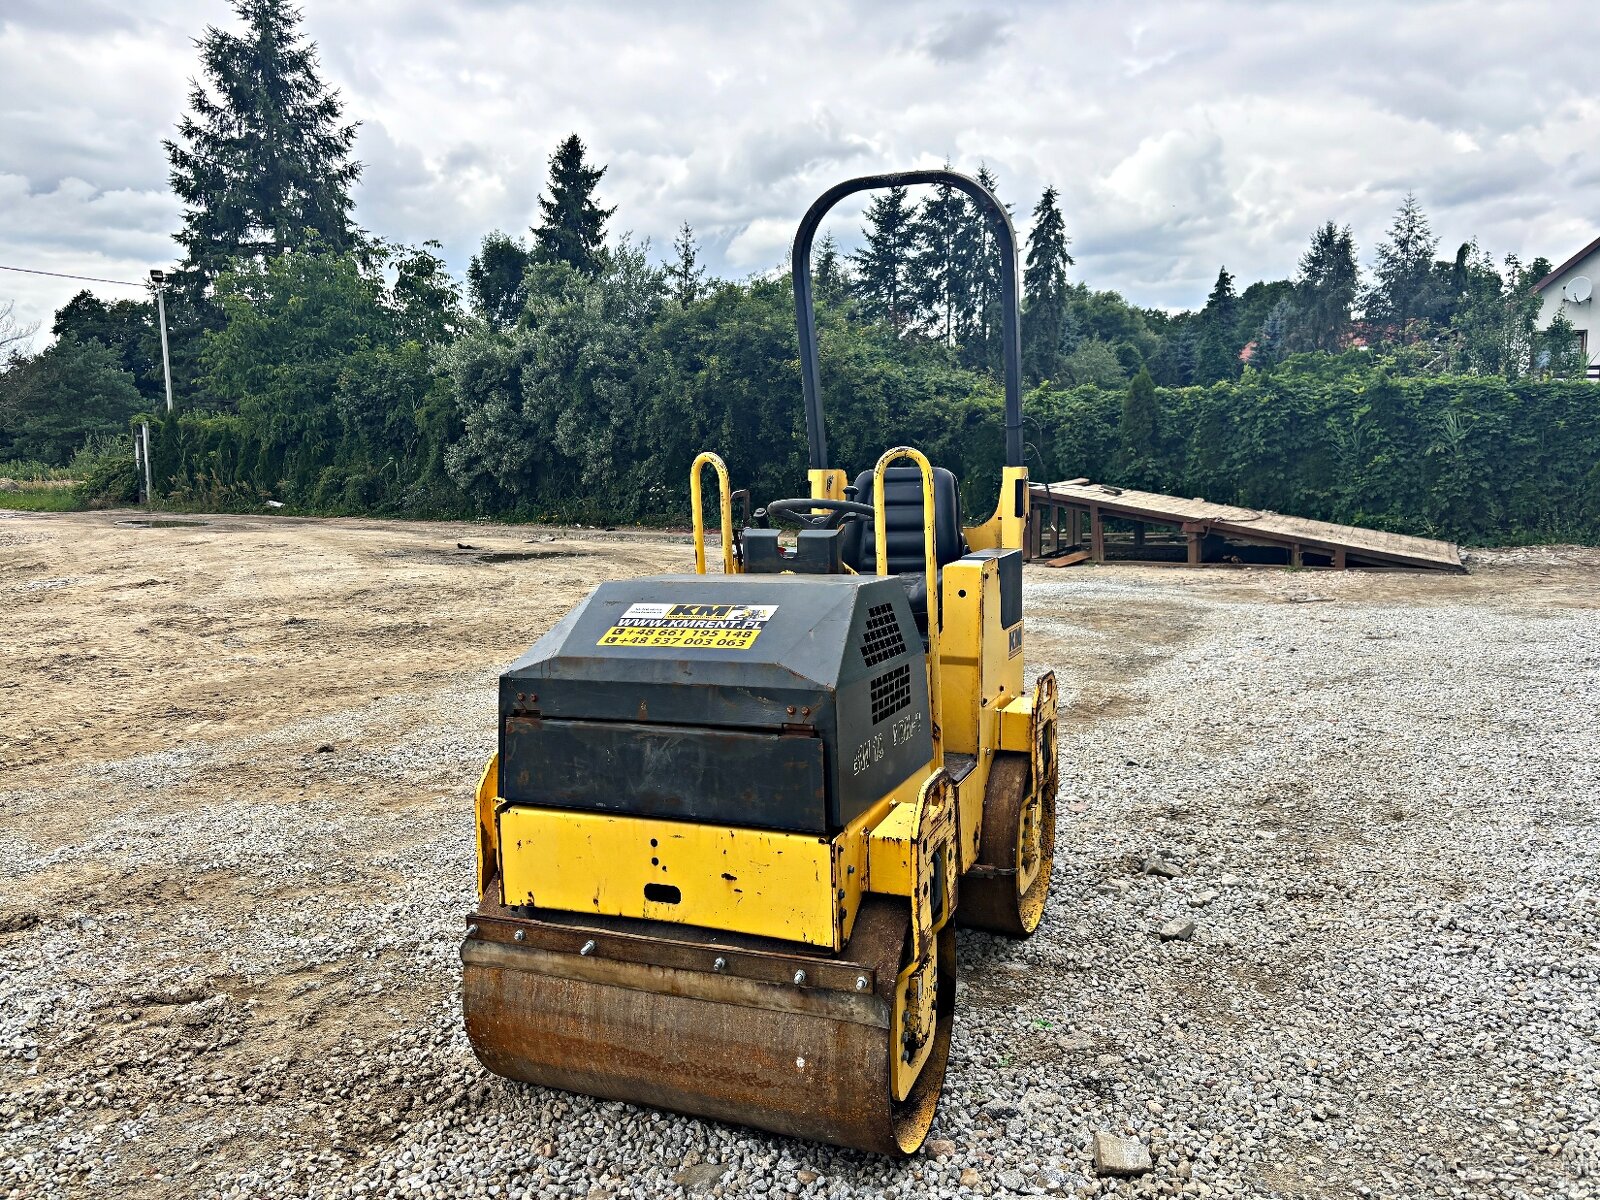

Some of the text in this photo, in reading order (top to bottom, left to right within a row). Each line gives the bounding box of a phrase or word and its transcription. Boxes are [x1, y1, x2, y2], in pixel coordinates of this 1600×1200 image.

[669, 605, 732, 616] KM
[619, 618, 762, 629] WWW.KMRENT.PL
[716, 639, 746, 647] 063
